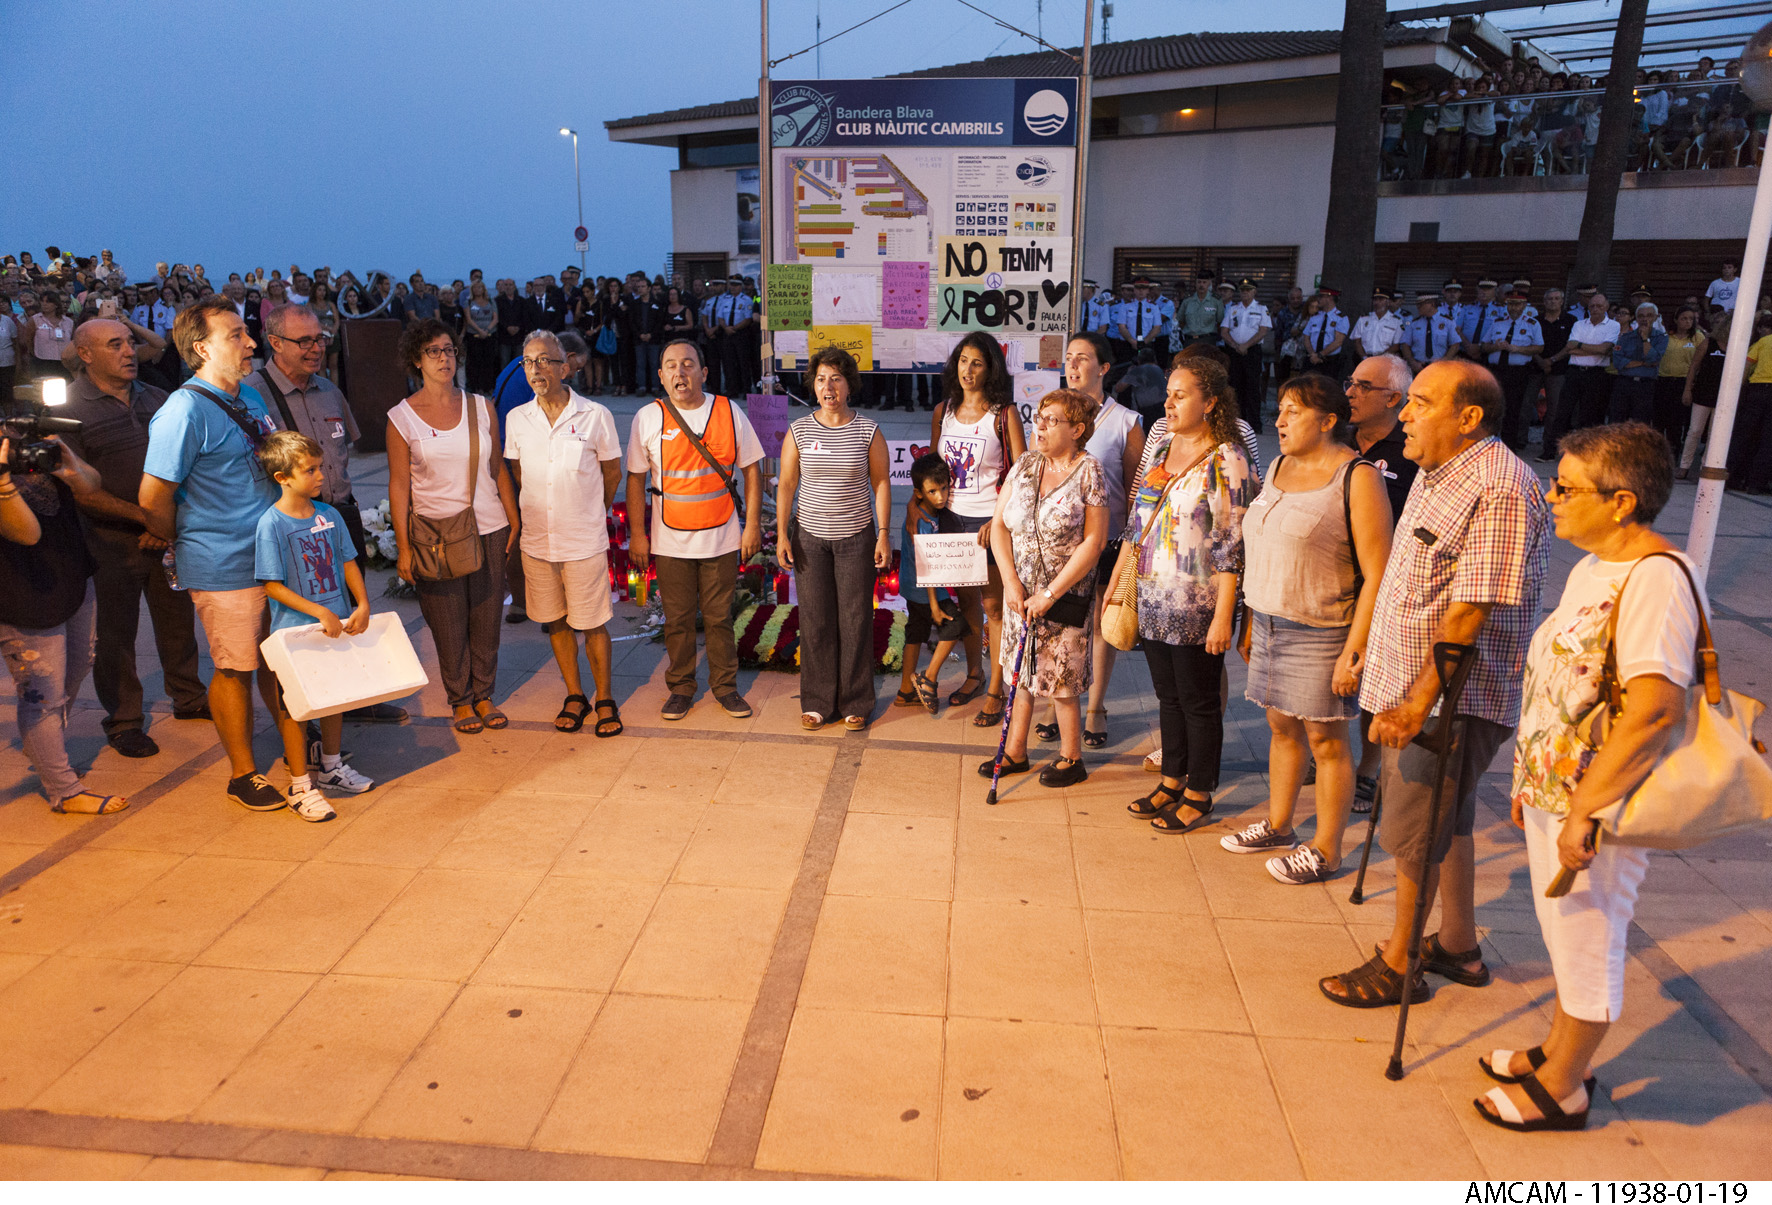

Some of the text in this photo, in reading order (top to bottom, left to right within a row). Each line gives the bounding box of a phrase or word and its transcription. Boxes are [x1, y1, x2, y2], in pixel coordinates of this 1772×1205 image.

[779, 89, 798, 103] CLUB
[836, 105, 934, 119] Bandera Blava
[805, 112, 828, 146] CAMBRILS
[836, 119, 1004, 135] CLUB NÀUTIC CAMBRILS
[945, 242, 988, 277] NO
[778, 280, 809, 290] FUERON
[768, 289, 788, 298] PARA
[768, 299, 809, 307] REGRESAR
[811, 328, 825, 340] NO
[827, 338, 864, 348] TENEMOS
[767, 397, 782, 408] AL
[894, 447, 906, 463] I
